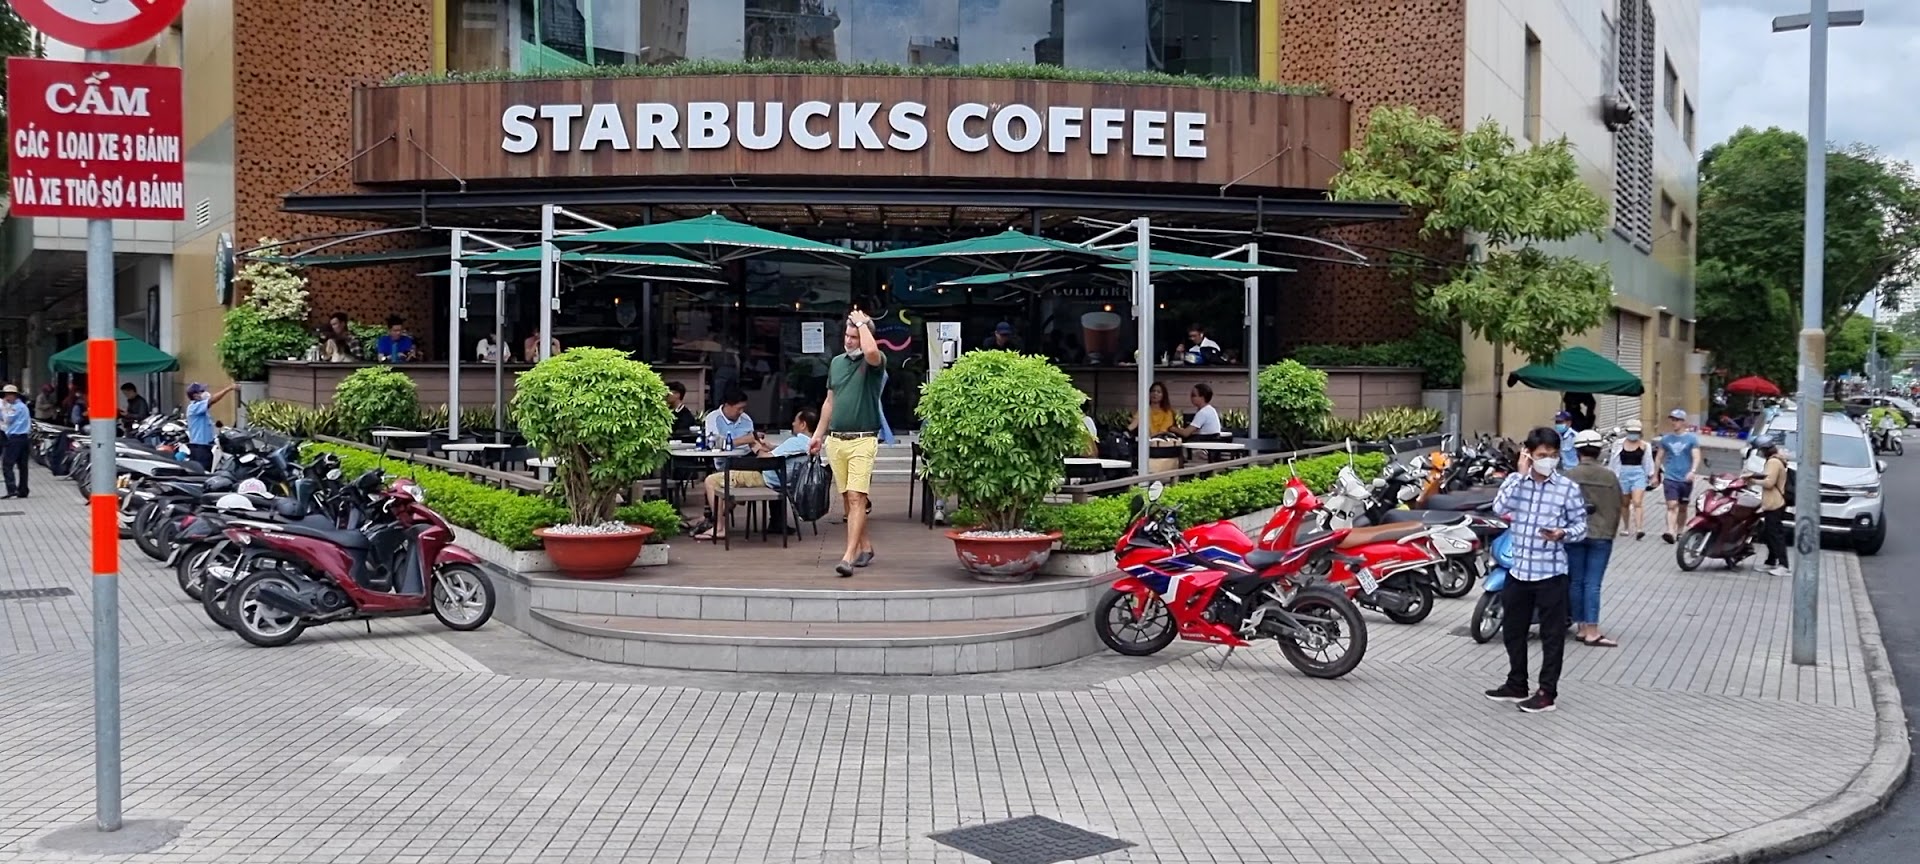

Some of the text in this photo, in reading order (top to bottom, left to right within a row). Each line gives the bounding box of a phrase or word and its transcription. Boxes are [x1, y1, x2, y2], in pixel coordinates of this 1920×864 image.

[45, 71, 150, 117] CẤM
[15, 121, 179, 168] CÁC LOẠI XE 3 BÁNH
[501, 101, 1207, 158] STARBUCKS COFFEE
[13, 169, 183, 208] VÀ XE THÔ SƠ 4 BÁNH
